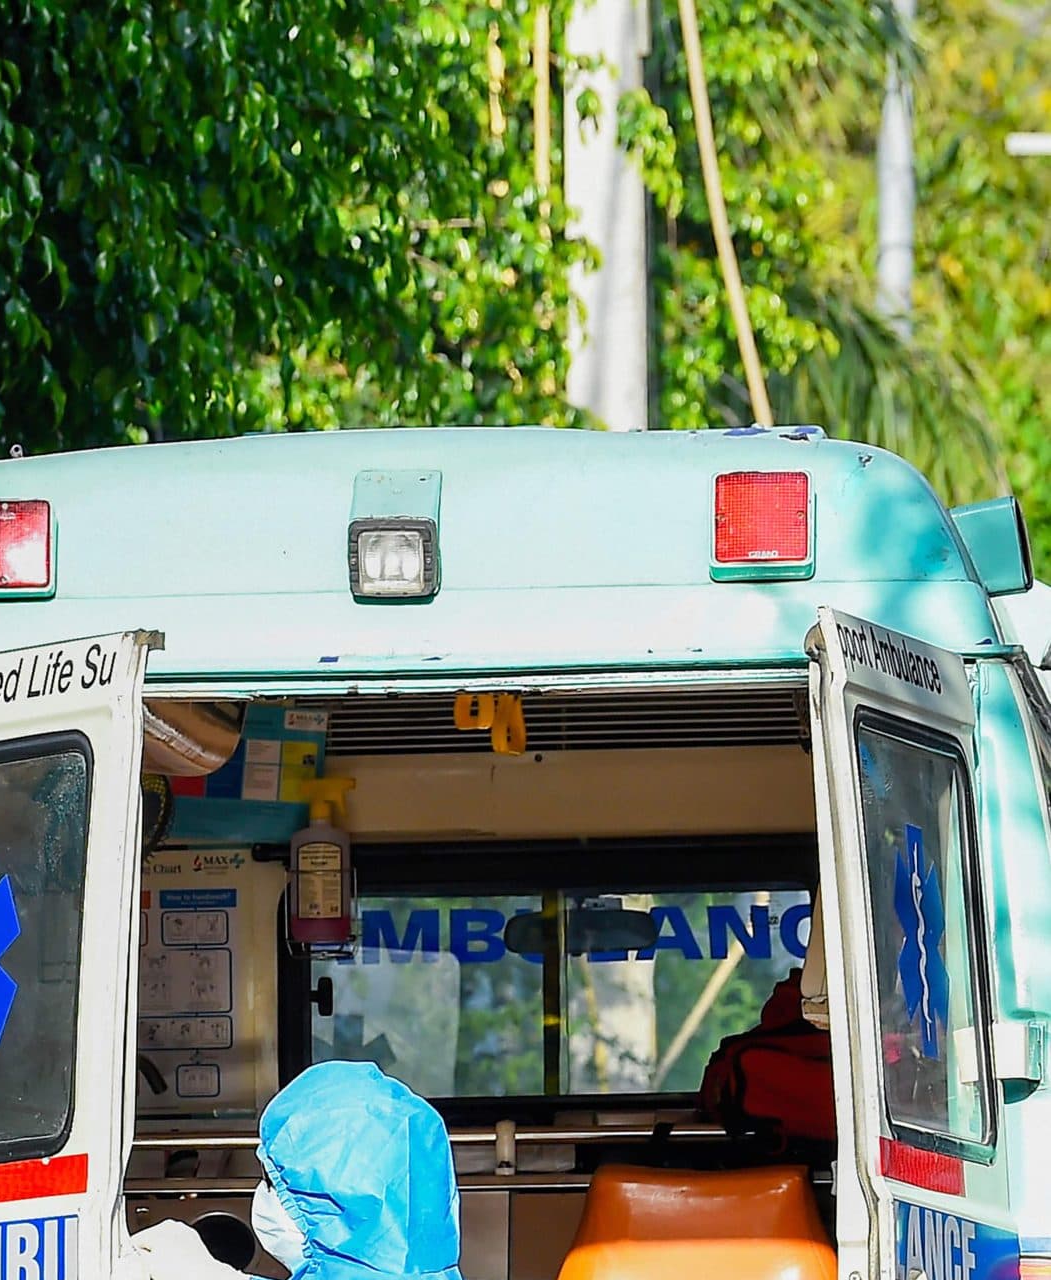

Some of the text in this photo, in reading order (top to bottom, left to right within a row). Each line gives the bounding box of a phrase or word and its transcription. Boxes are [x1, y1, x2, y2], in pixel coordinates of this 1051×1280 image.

[26, 650, 74, 699] Life
[80, 643, 118, 690] Su
[869, 626, 942, 695] Ambulance
